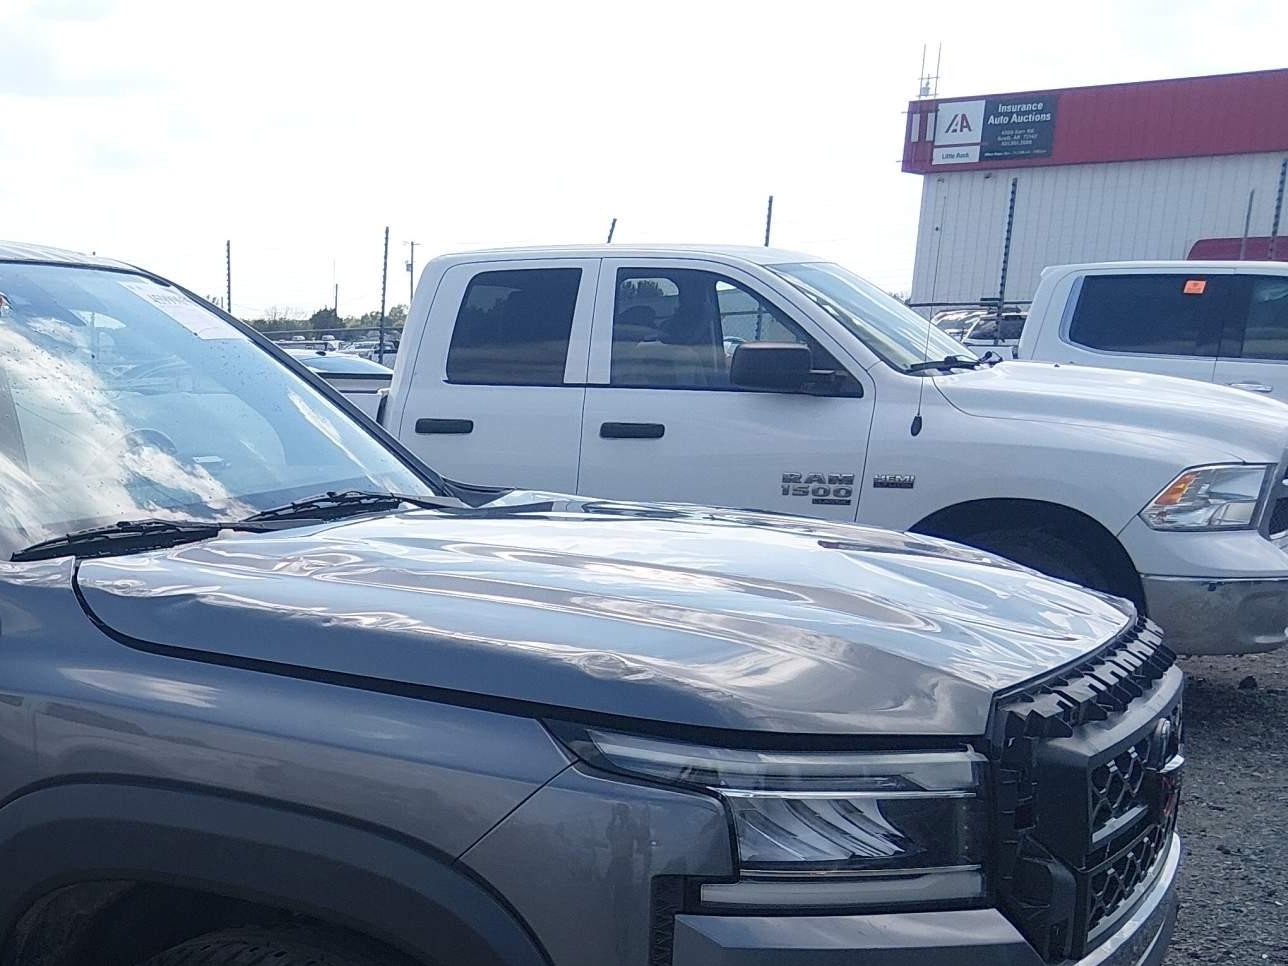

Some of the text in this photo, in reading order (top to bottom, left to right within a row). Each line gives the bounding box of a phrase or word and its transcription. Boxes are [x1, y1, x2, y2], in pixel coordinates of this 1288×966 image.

[998, 102, 1044, 113] Insurance
[987, 111, 1051, 125] Auto Auctions
[782, 472, 855, 485] RAM
[781, 484, 853, 498] 1500
